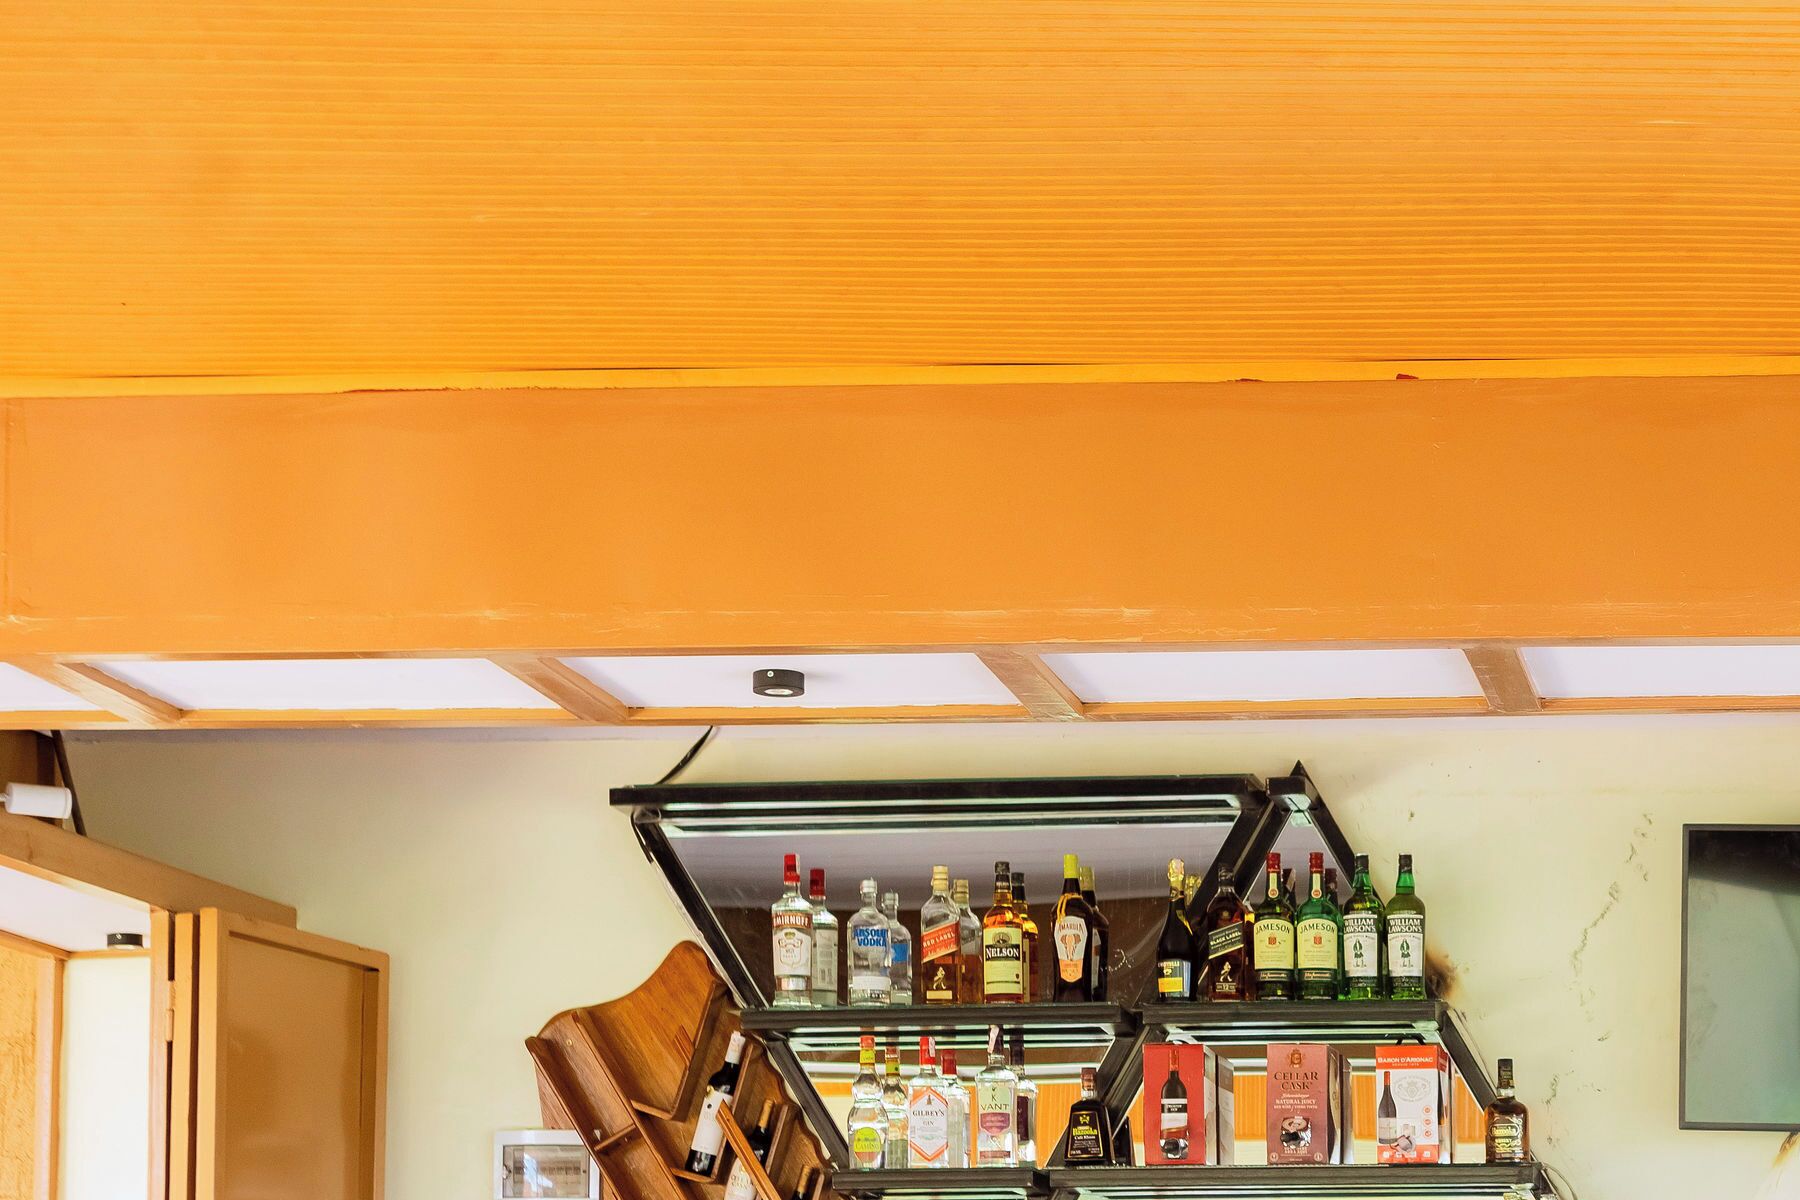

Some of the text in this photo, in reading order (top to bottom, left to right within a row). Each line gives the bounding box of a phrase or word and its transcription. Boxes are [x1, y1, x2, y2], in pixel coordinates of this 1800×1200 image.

[1389, 918, 1421, 926] WILLIAM
[1255, 923, 1291, 935] JAMESON
[1299, 922, 1335, 935] JAMESON
[1388, 925, 1423, 933] LAWSON'S
[985, 947, 1019, 959] NELSON
[1274, 1071, 1319, 1081] CELLAR
[1281, 1081, 1311, 1090] CASK
[980, 1103, 1010, 1111] VANT
